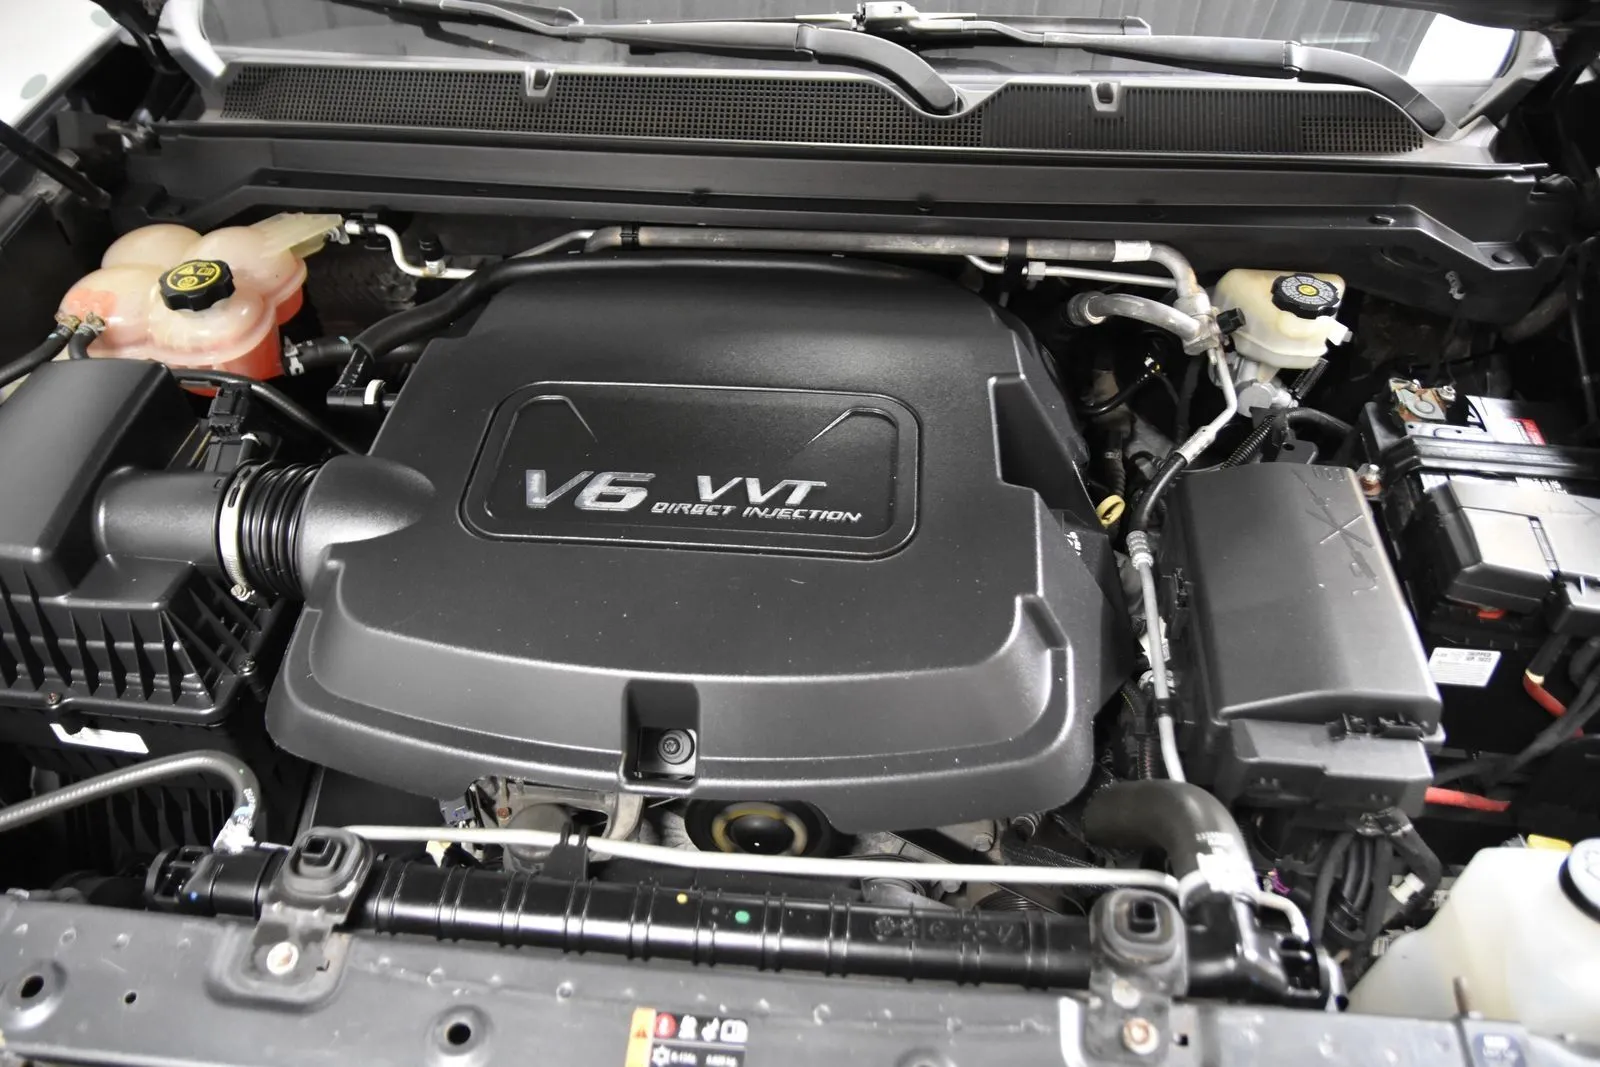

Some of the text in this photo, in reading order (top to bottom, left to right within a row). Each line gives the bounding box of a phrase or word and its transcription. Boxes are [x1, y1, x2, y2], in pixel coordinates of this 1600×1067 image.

[526, 470, 827, 511] V6 VVT
[650, 501, 862, 523] DIRECT INJECTION
